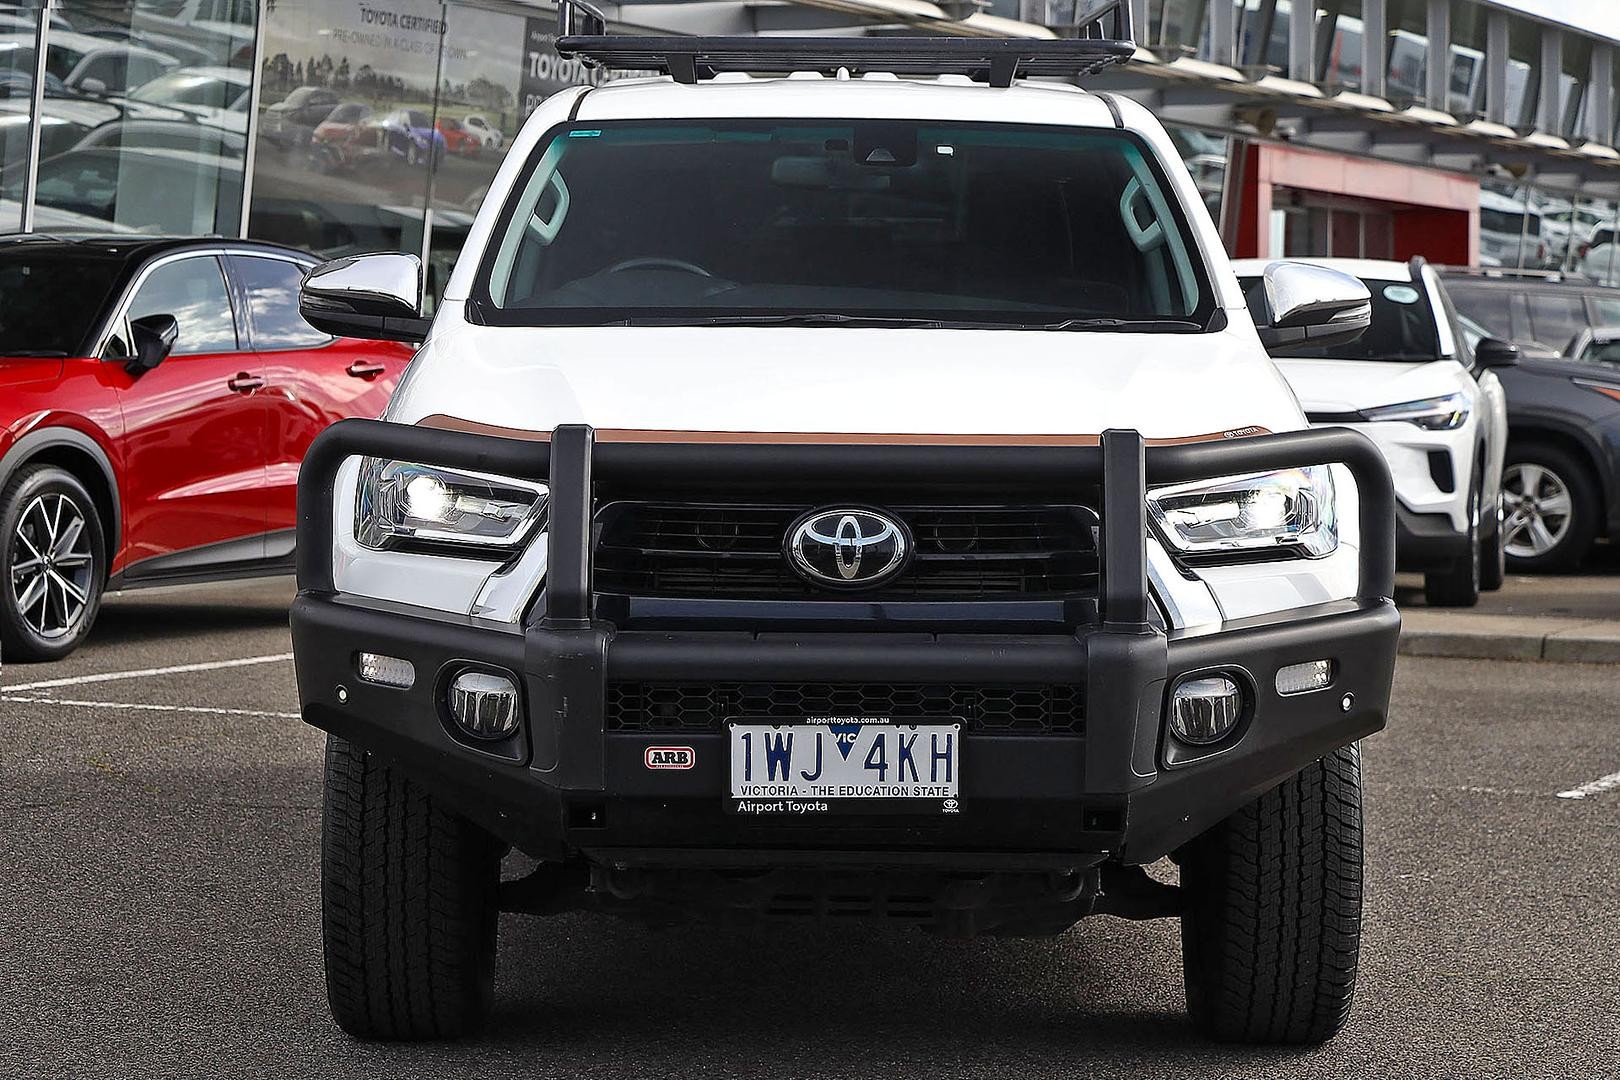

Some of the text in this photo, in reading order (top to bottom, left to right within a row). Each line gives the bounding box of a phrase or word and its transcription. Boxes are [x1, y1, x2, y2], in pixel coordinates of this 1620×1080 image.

[360, 8, 446, 35] TOYOTA CERTIFIED
[529, 51, 590, 86] TOYOTA
[806, 716, 890, 726] airporttoyota.com.au
[835, 733, 857, 743] VIC
[651, 751, 689, 764] ARB
[740, 785, 799, 796] VICTORIA
[811, 785, 835, 796] THE
[839, 785, 909, 797] EDUCATION
[913, 786, 949, 797] STATE
[737, 800, 828, 815] Airport Toyota
